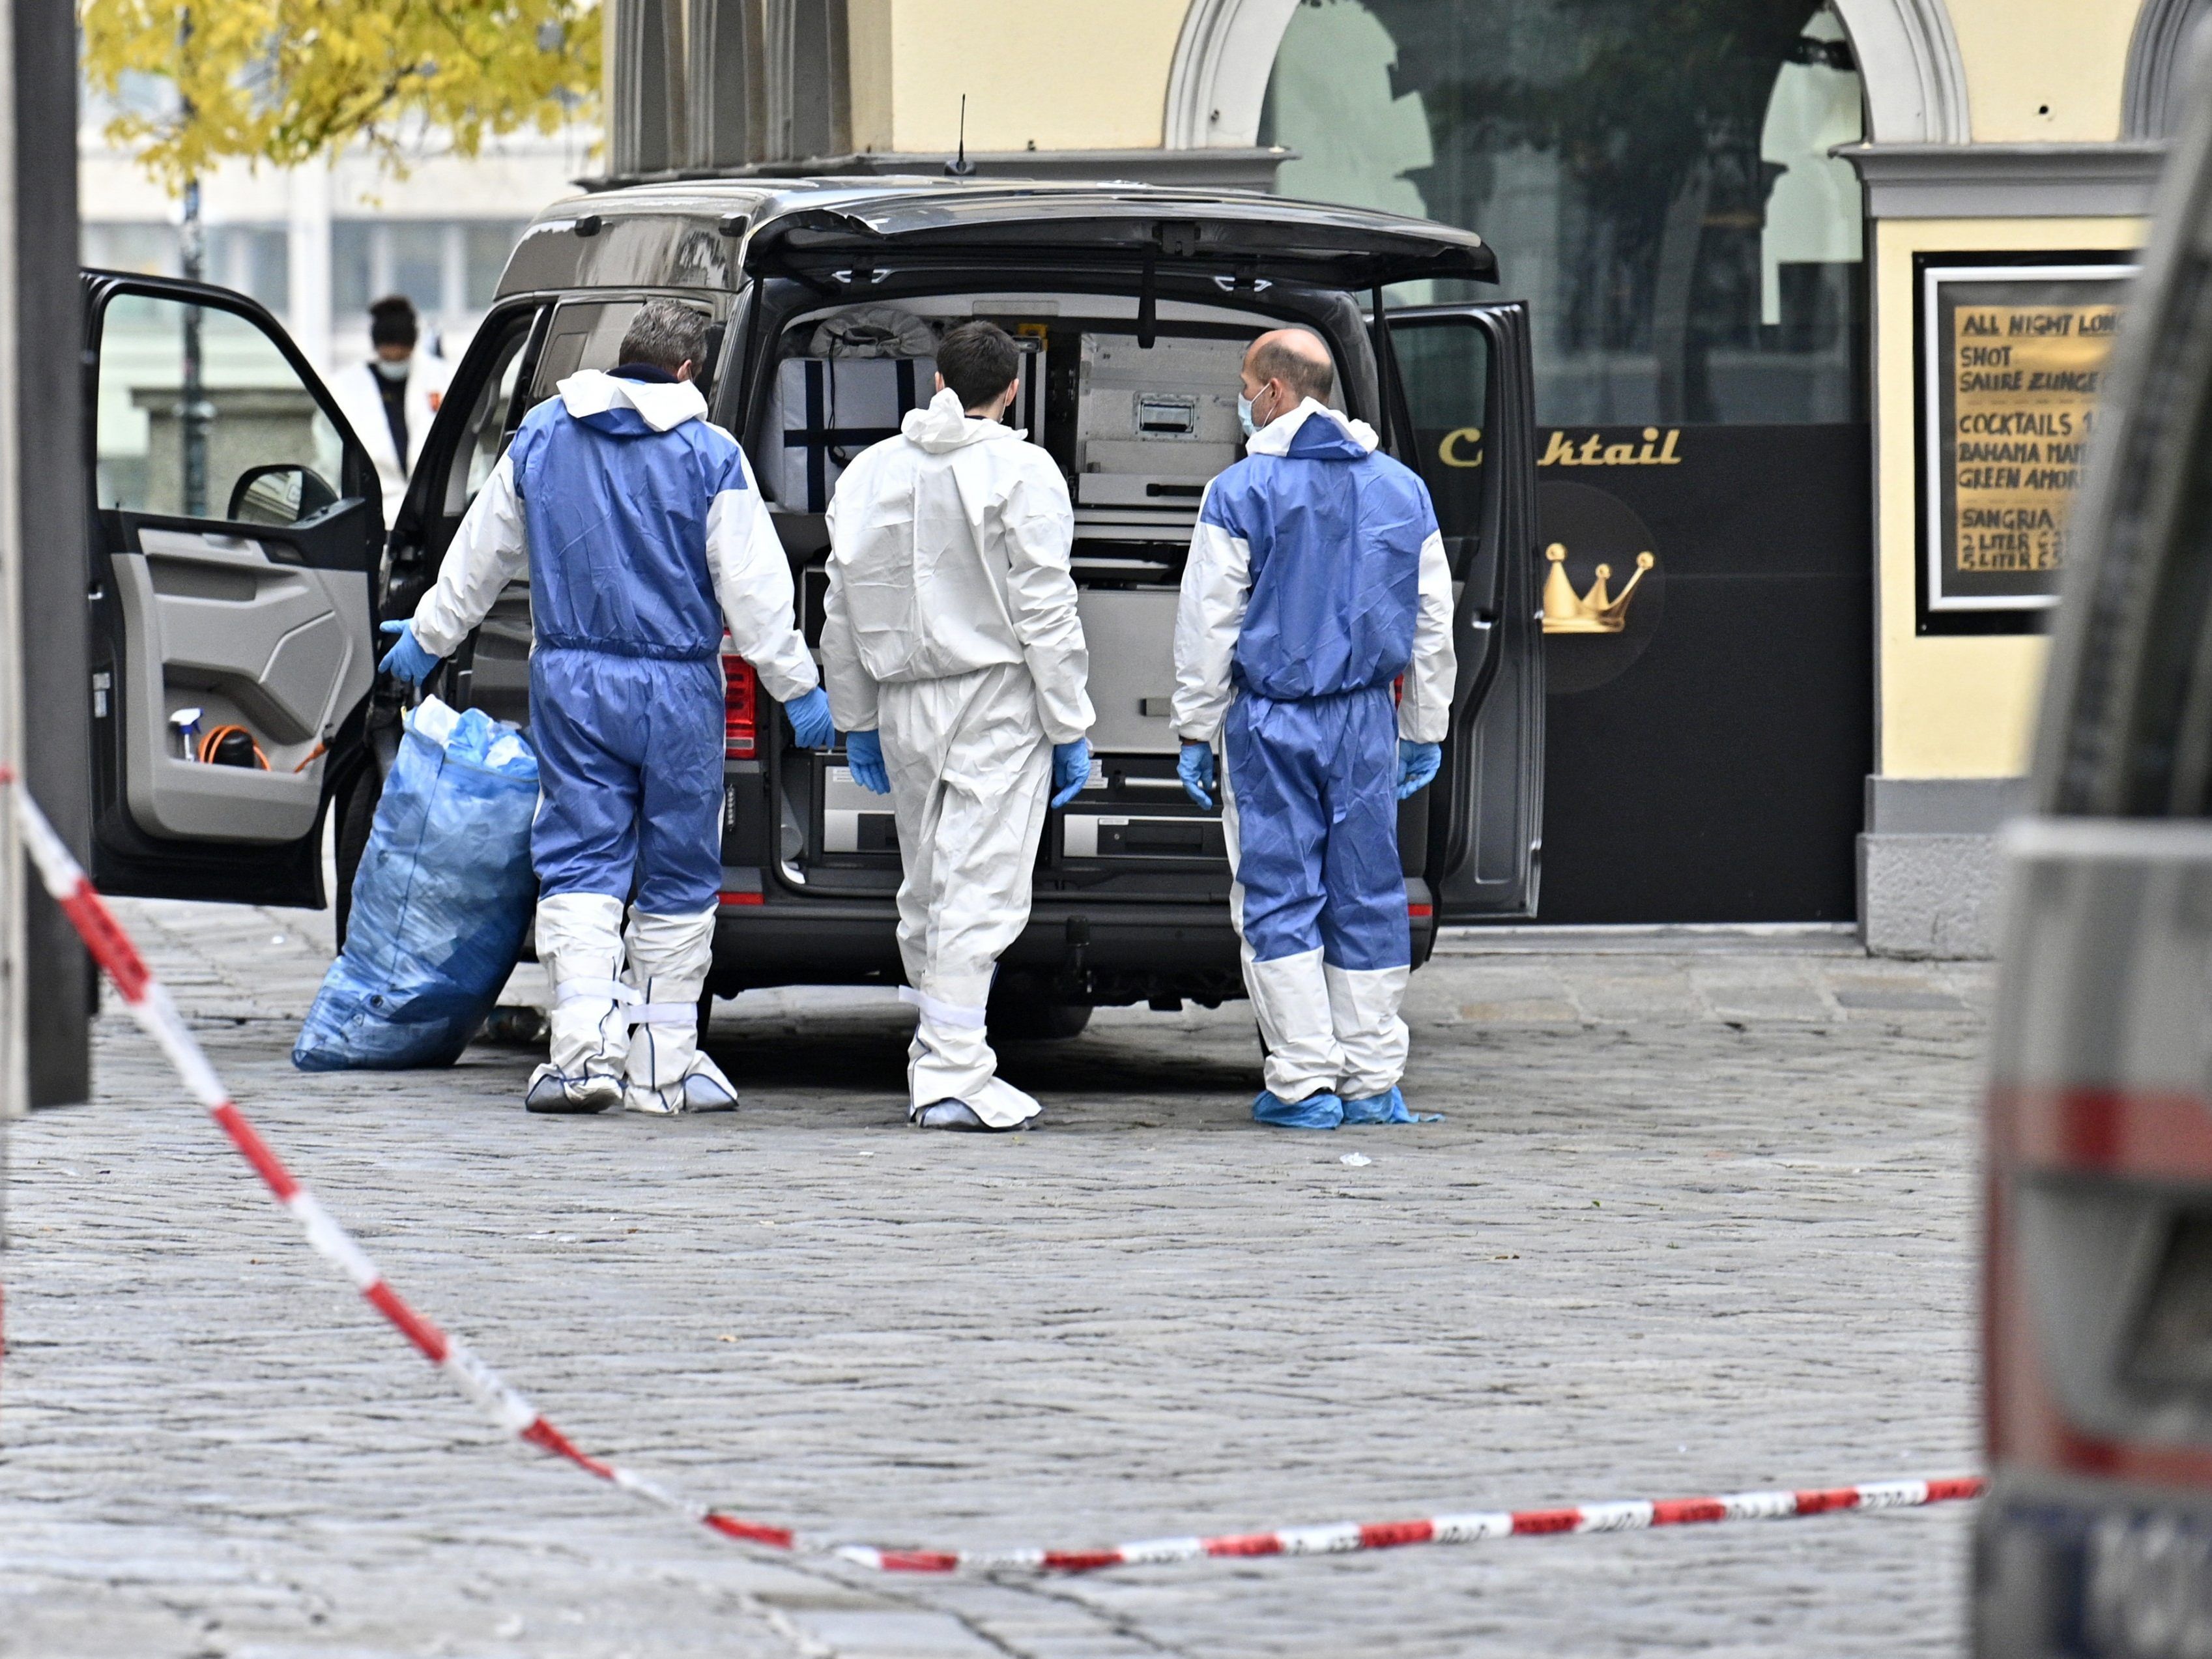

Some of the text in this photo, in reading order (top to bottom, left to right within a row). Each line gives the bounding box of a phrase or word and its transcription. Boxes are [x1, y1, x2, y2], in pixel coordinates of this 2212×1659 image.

[1963, 314, 2119, 336] ALL NIGHT LON
[1960, 345, 2011, 368] SHOT
[1959, 412, 2072, 436] COCKTAILS
[1439, 427, 1682, 468] Cktail
[1959, 442, 2040, 463] BAHAMA
[1959, 467, 2021, 489] GREEN
[1962, 509, 2054, 529] SANGRIA
[1979, 533, 2029, 551] LITER
